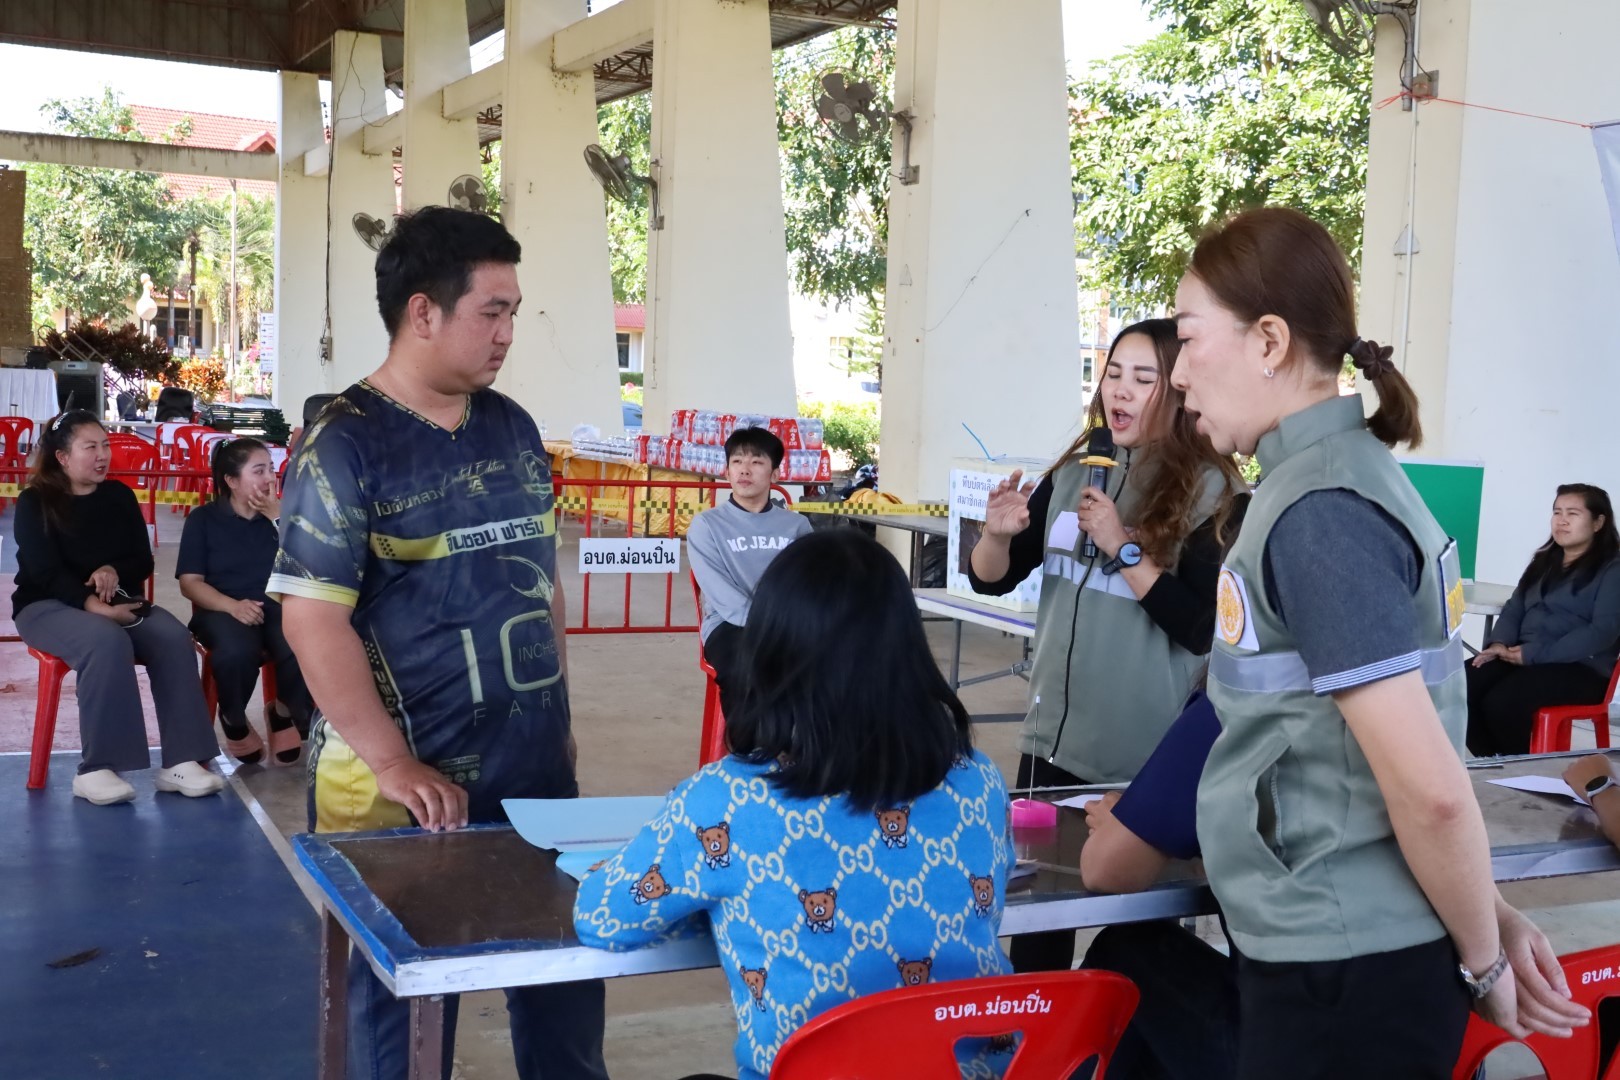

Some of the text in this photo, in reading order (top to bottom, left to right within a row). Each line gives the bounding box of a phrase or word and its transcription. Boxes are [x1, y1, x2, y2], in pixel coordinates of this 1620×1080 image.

[500, 518, 545, 541] ฟาร์ม
[583, 541, 676, 565] อบต.ม่อนปิ่น
[1582, 967, 1615, 984] อบต.
[934, 989, 1052, 1021] อบต. ม่อนปิ่น
